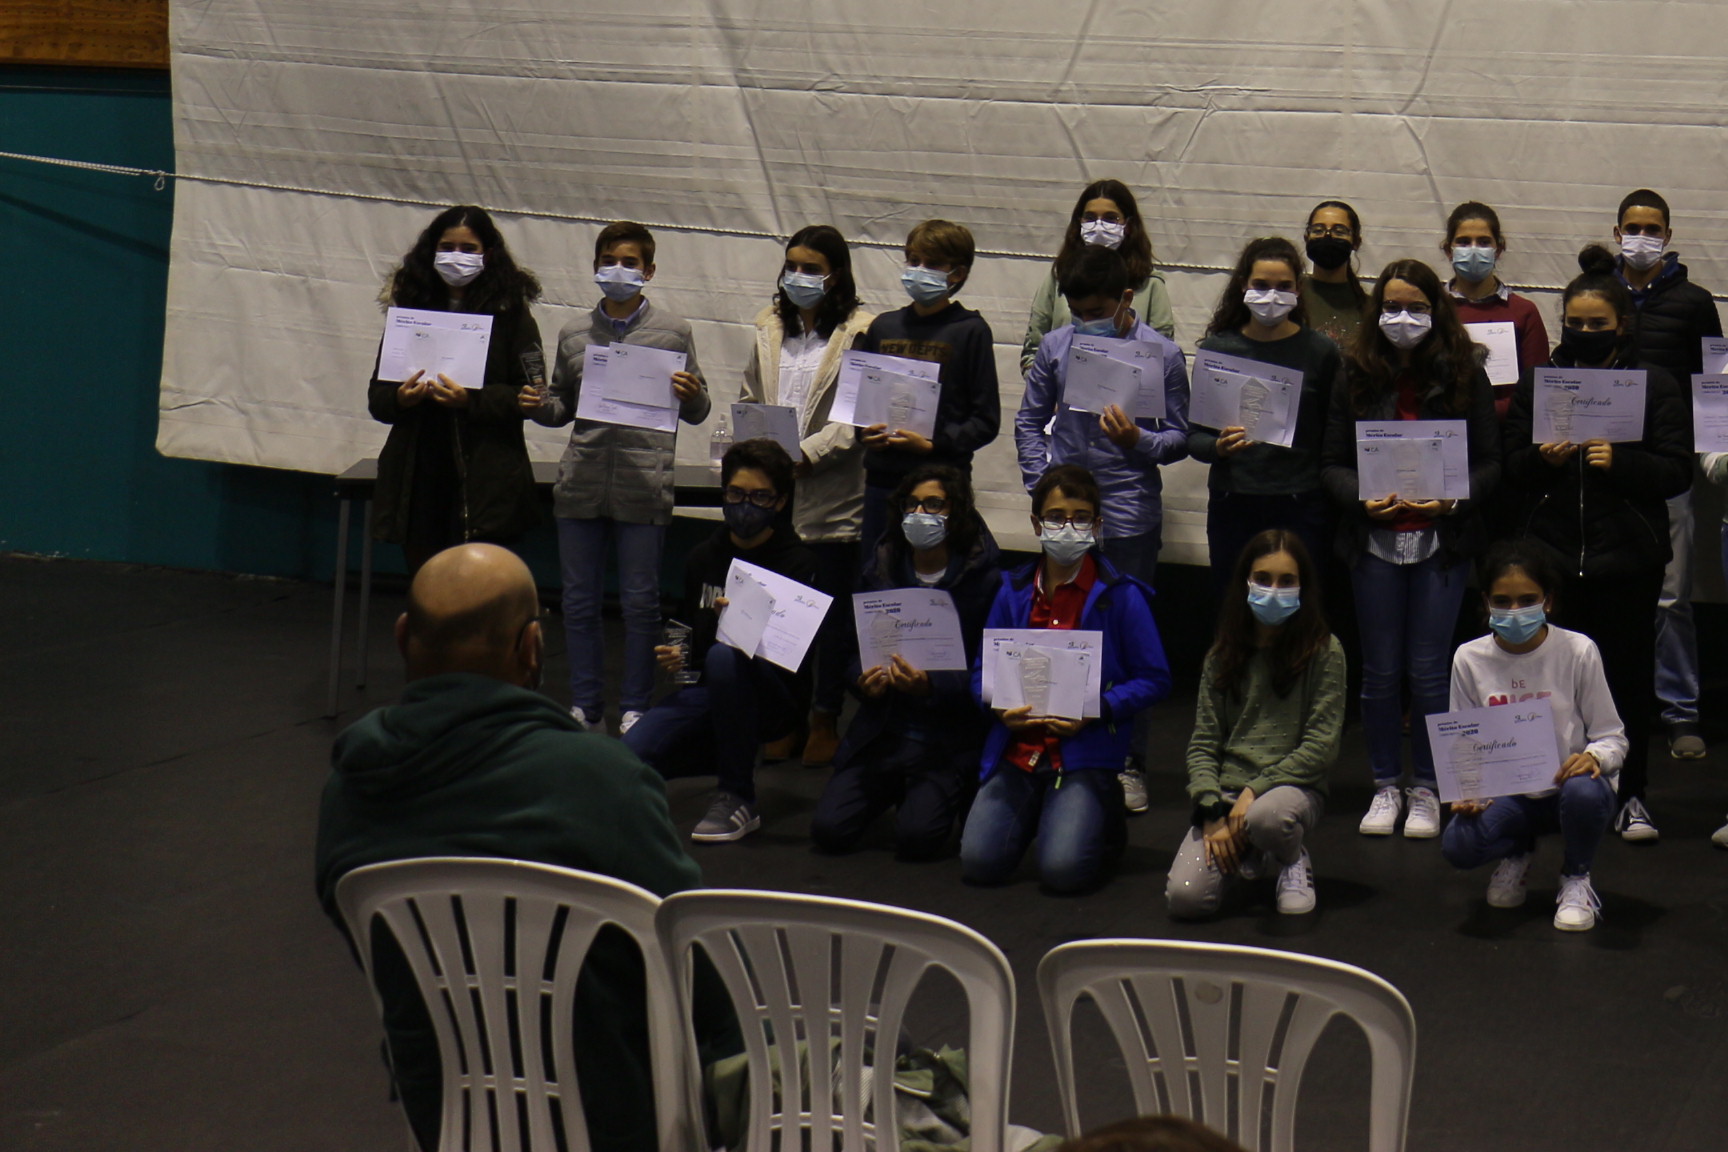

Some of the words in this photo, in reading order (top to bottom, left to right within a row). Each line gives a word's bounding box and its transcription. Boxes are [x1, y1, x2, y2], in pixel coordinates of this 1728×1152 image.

[1571, 397, 1612, 408] Certificado
[895, 619, 932, 631] Certificado
[1473, 737, 1517, 753] Certificado
